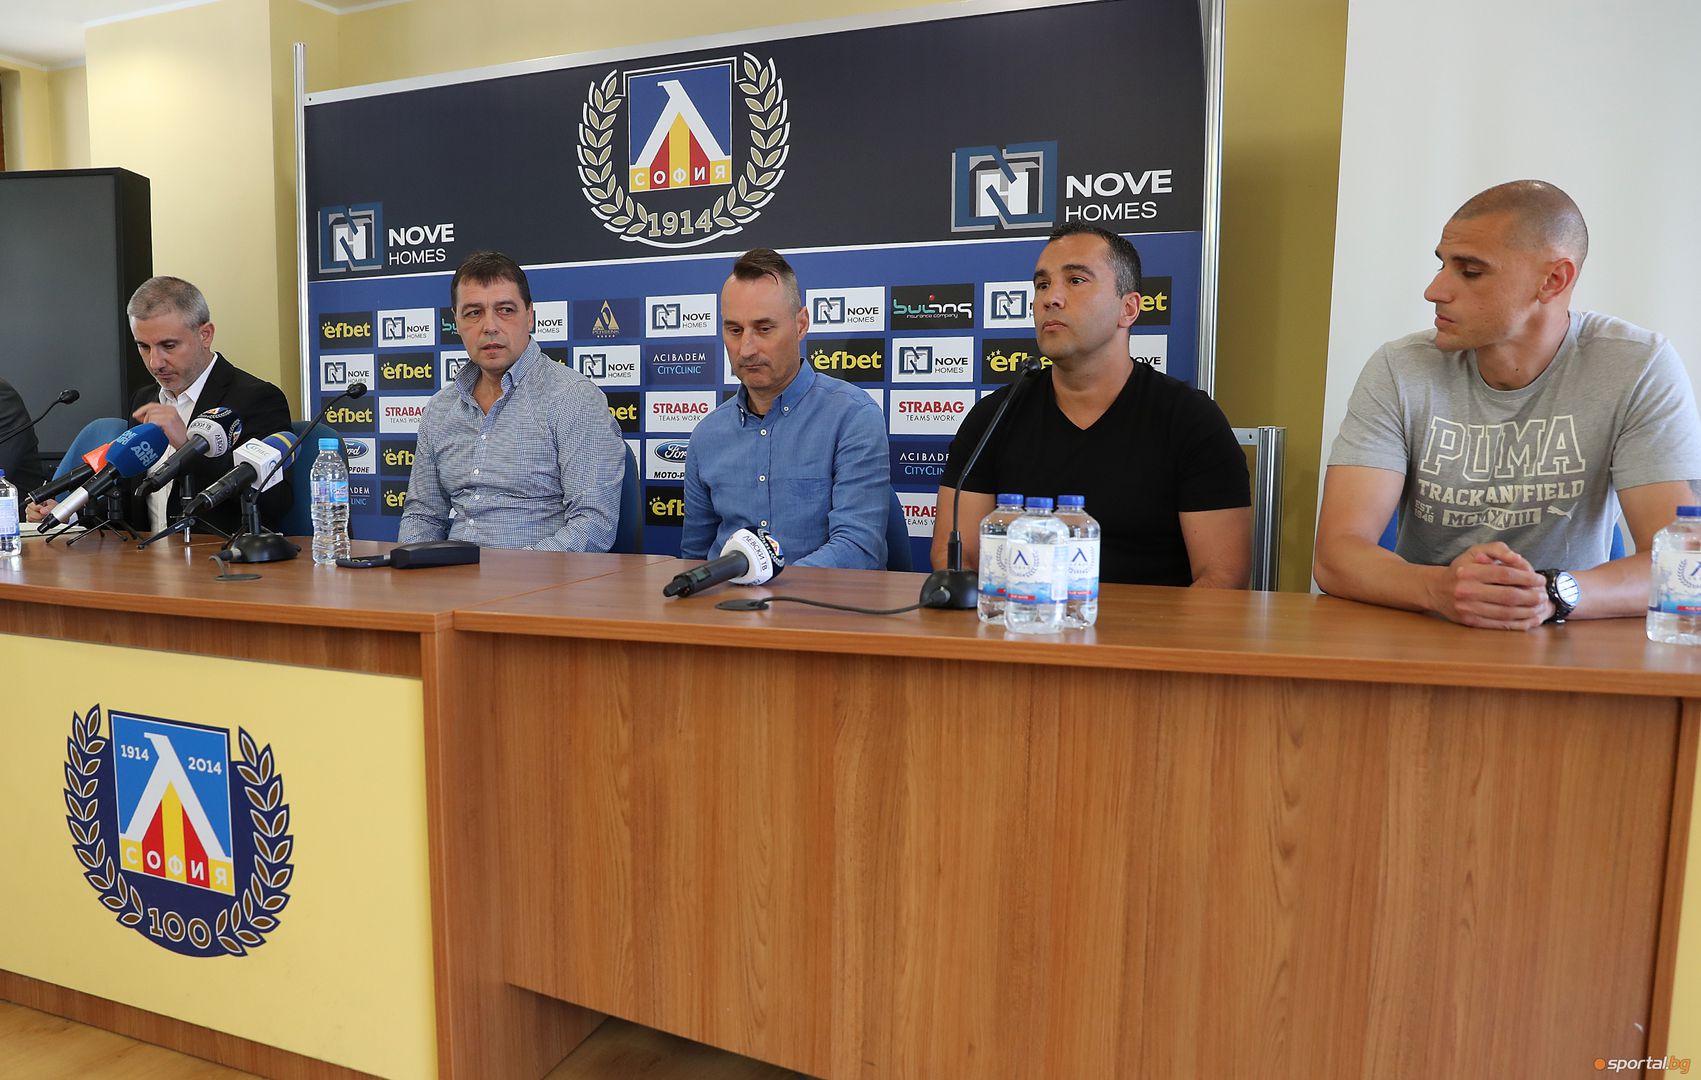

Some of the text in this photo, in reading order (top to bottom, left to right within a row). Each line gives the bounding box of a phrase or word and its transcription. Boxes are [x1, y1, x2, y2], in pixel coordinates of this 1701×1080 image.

[634, 164, 726, 186] СОФИЯ
[1065, 169, 1173, 199] NOVE
[1065, 201, 1158, 223] HOMES
[647, 208, 713, 237] 1914
[388, 224, 454, 246] NOVE
[389, 248, 446, 266] HOMES
[682, 312, 711, 321] NOVE
[847, 306, 880, 316] NOVE
[324, 322, 371, 338] efbet
[538, 318, 563, 326] NOVE
[653, 353, 706, 362] ACIBADEM
[814, 350, 882, 370] efbet
[935, 357, 969, 366] NOVE
[383, 363, 432, 380] efbet
[326, 406, 373, 423] efbet
[653, 402, 708, 414] STRABAG
[898, 401, 964, 413] STRABAG
[664, 444, 687, 458] For
[1420, 414, 1586, 482] PUMA
[385, 450, 415, 466] efb
[652, 499, 685, 516] efb
[120, 744, 150, 762] 1914
[188, 757, 222, 776] 2014
[125, 846, 228, 886] СОФИЯ
[147, 907, 212, 949] 100
